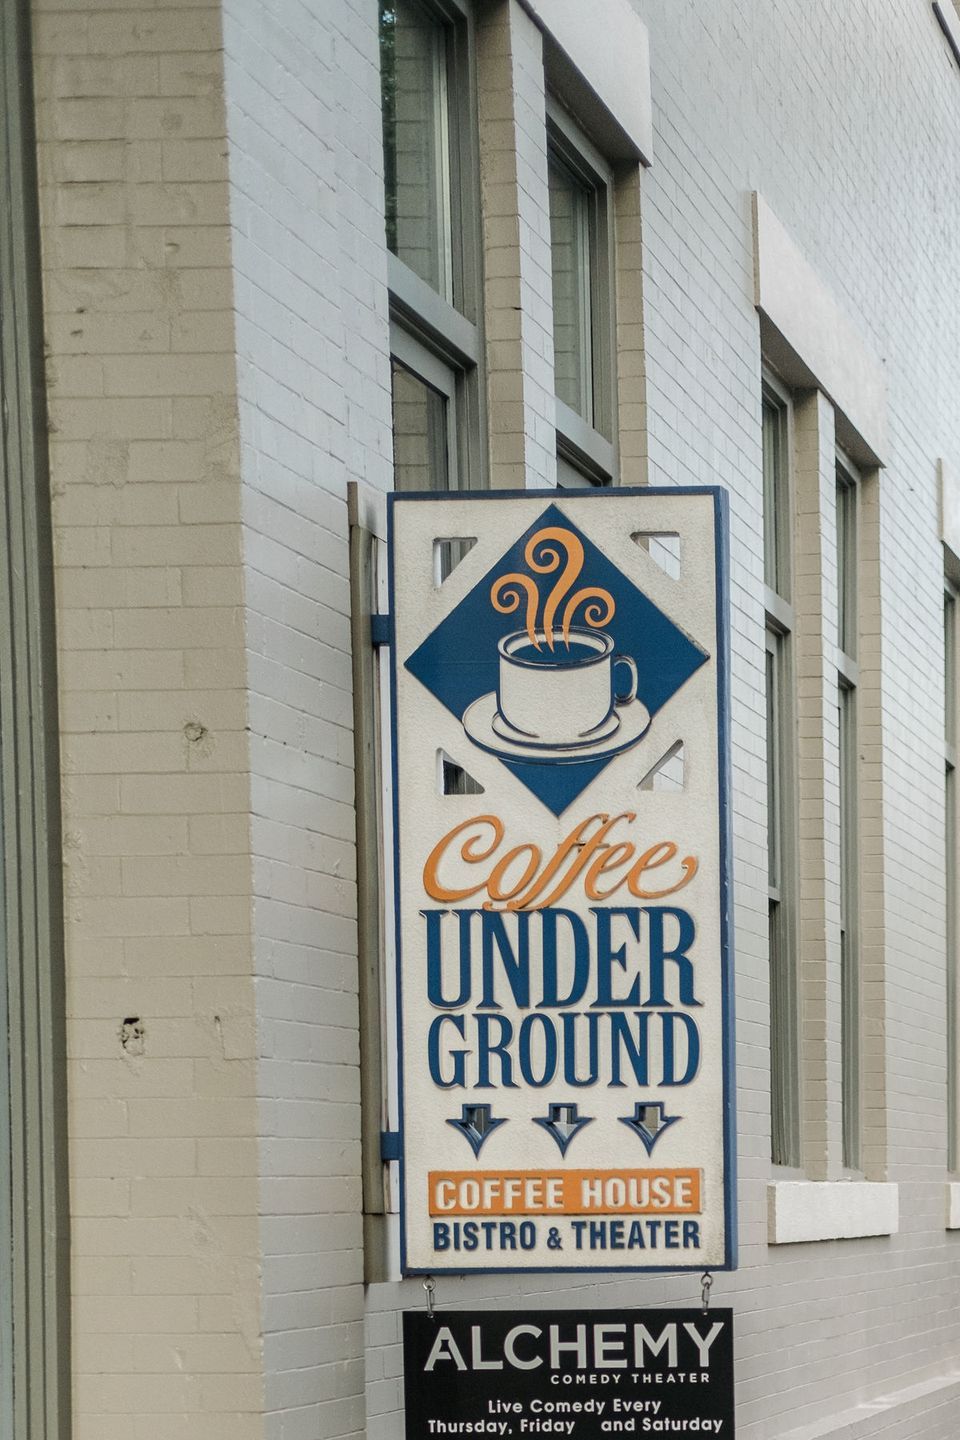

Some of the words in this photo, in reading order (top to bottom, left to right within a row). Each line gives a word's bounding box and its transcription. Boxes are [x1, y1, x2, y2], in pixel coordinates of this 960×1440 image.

[423, 812, 698, 913] Coffee
[422, 906, 703, 1008] UNDER
[427, 1011, 701, 1089] GROUND
[436, 1178, 564, 1209] COFFEE
[581, 1177, 692, 1208] HOUSE
[433, 1220, 537, 1251] BISTRO
[547, 1227, 563, 1250] &
[571, 1220, 701, 1250] THEATER
[424, 1322, 725, 1371] ALCHEMY
[550, 1373, 622, 1385] COMEDY
[631, 1372, 710, 1384] THEATER
[488, 1399, 523, 1414] Live
[529, 1399, 606, 1416] Comedy
[613, 1398, 662, 1415] Every
[427, 1419, 513, 1435] Thursday,
[520, 1418, 576, 1435] Friday
[600, 1417, 635, 1432] and
[642, 1416, 724, 1433] Saturday
